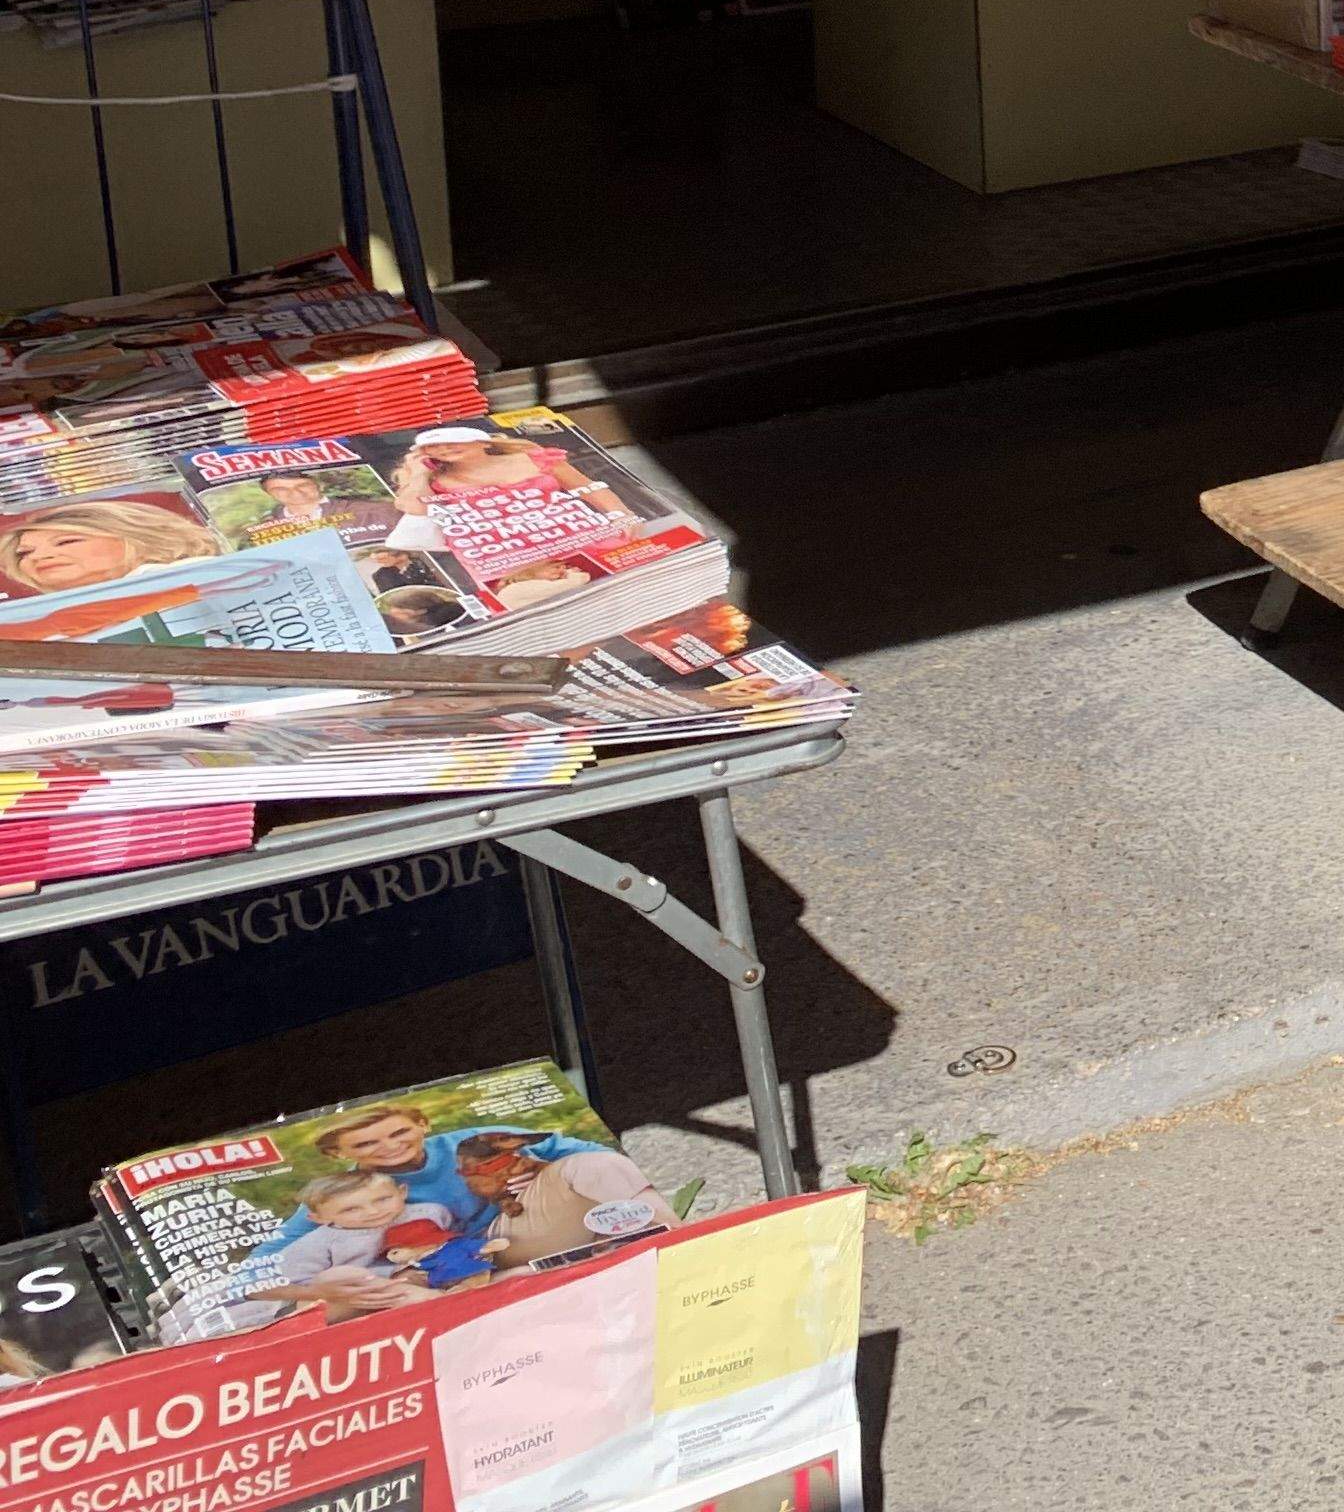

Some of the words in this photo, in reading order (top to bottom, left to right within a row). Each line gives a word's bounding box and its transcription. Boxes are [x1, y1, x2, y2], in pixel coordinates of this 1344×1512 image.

[192, 439, 362, 482] SEMANA
[425, 500, 470, 518] Así
[481, 493, 509, 510] es
[511, 486, 544, 501] la
[433, 506, 501, 529] vida
[510, 495, 547, 515] de
[550, 479, 610, 505] Ana
[441, 498, 591, 538] Obregón
[452, 533, 494, 550] en
[497, 502, 595, 540] Miami
[461, 537, 524, 560] con
[527, 526, 565, 545] su
[567, 508, 627, 533] hija
[287, 566, 346, 651] EMPORÁNEA
[29, 947, 104, 1010] LA
[97, 839, 509, 995] VANGUARDIA
[130, 1139, 267, 1185] ¡HOLA!
[139, 1186, 236, 1227] MARÍA
[146, 1199, 256, 1241] ZURITA
[154, 1218, 237, 1251] CUENTA
[234, 1208, 275, 1226] POR
[159, 1224, 247, 1263] PRIMERA
[248, 1217, 287, 1234] VEZ
[165, 1254, 192, 1274] LA
[195, 1229, 286, 1261] HISTORIA
[170, 1265, 200, 1285] DE
[200, 1252, 229, 1270] SU
[175, 1267, 225, 1293] VIDA
[226, 1252, 285, 1275] COMO
[183, 1270, 256, 1306] MADRE
[254, 1264, 282, 1278] EN
[189, 1275, 291, 1316] SOLITARIO
[682, 1274, 756, 1309] BYPHASSE
[217, 1326, 427, 1428] BEAUTY
[462, 1350, 545, 1391] BYPHASSE
[679, 1355, 754, 1386] ILLUMINATEUR
[28, 1441, 260, 1512] ASCARILLAS
[266, 1390, 423, 1463] FACIALES
[473, 1429, 555, 1470] HYDRATANT
